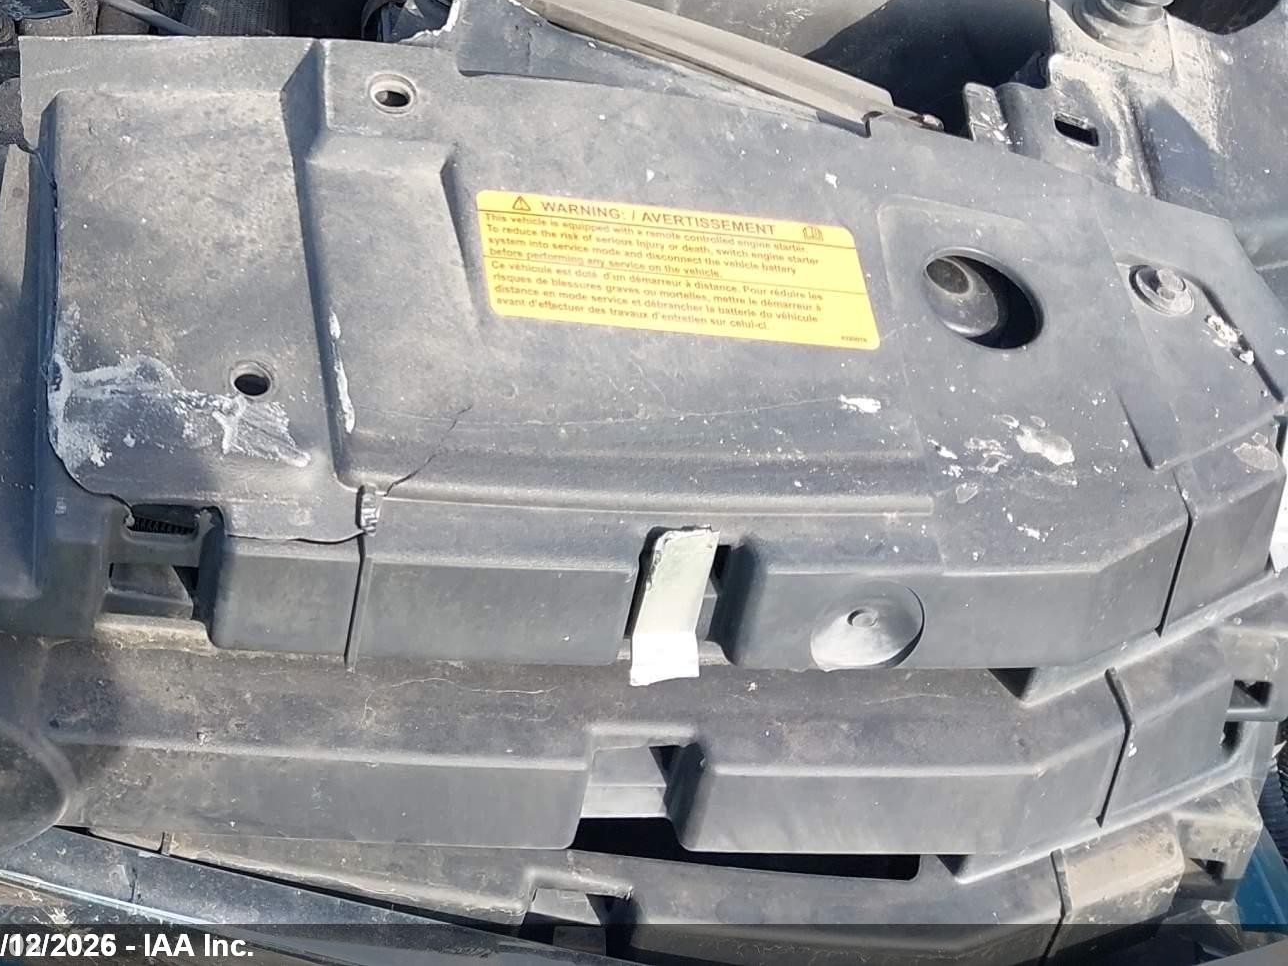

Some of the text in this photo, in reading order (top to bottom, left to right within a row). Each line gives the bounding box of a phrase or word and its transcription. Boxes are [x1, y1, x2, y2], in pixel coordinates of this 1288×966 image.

[485, 213, 507, 221] This
[511, 215, 546, 225] vehicle
[550, 219, 558, 227] is
[562, 221, 609, 233] equipped
[612, 226, 633, 234] with
[645, 229, 680, 239] remote
[683, 233, 734, 244] controlled
[736, 238, 770, 249] engine
[541, 201, 625, 219] WARNING:
[640, 211, 777, 235] AVERTISSEMENT
[487, 224, 497, 232] To
[501, 226, 537, 236] reduce
[540, 229, 556, 238] the
[560, 231, 578, 240] risk
[595, 235, 632, 245] serious
[715, 247, 748, 257] switch
[750, 251, 785, 262] engine
[787, 254, 819, 264] starter
[487, 236, 796, 274] system into service mode and disconnect the vehicle battery
[489, 247, 522, 257] before
[525, 251, 584, 265] performing
[587, 259, 604, 267] any
[607, 259, 644, 269] service
[663, 264, 681, 272] the
[490, 260, 505, 269] Ce
[555, 267, 572, 276] est
[742, 284, 766, 294] Pour
[807, 291, 822, 299] les
[492, 273, 532, 285] risques
[535, 277, 548, 285] de
[551, 278, 601, 290] blessures
[605, 285, 640, 295] graves
[712, 293, 745, 303] mettre
[494, 284, 538, 296] distance
[558, 290, 586, 300] mode
[590, 293, 628, 304] service
[630, 297, 641, 305] et
[705, 304, 715, 312] la
[717, 305, 756, 316] batterie
[758, 309, 772, 317] du
[496, 297, 525, 307] avant
[587, 305, 606, 314] des
[609, 307, 648, 318] travaux
